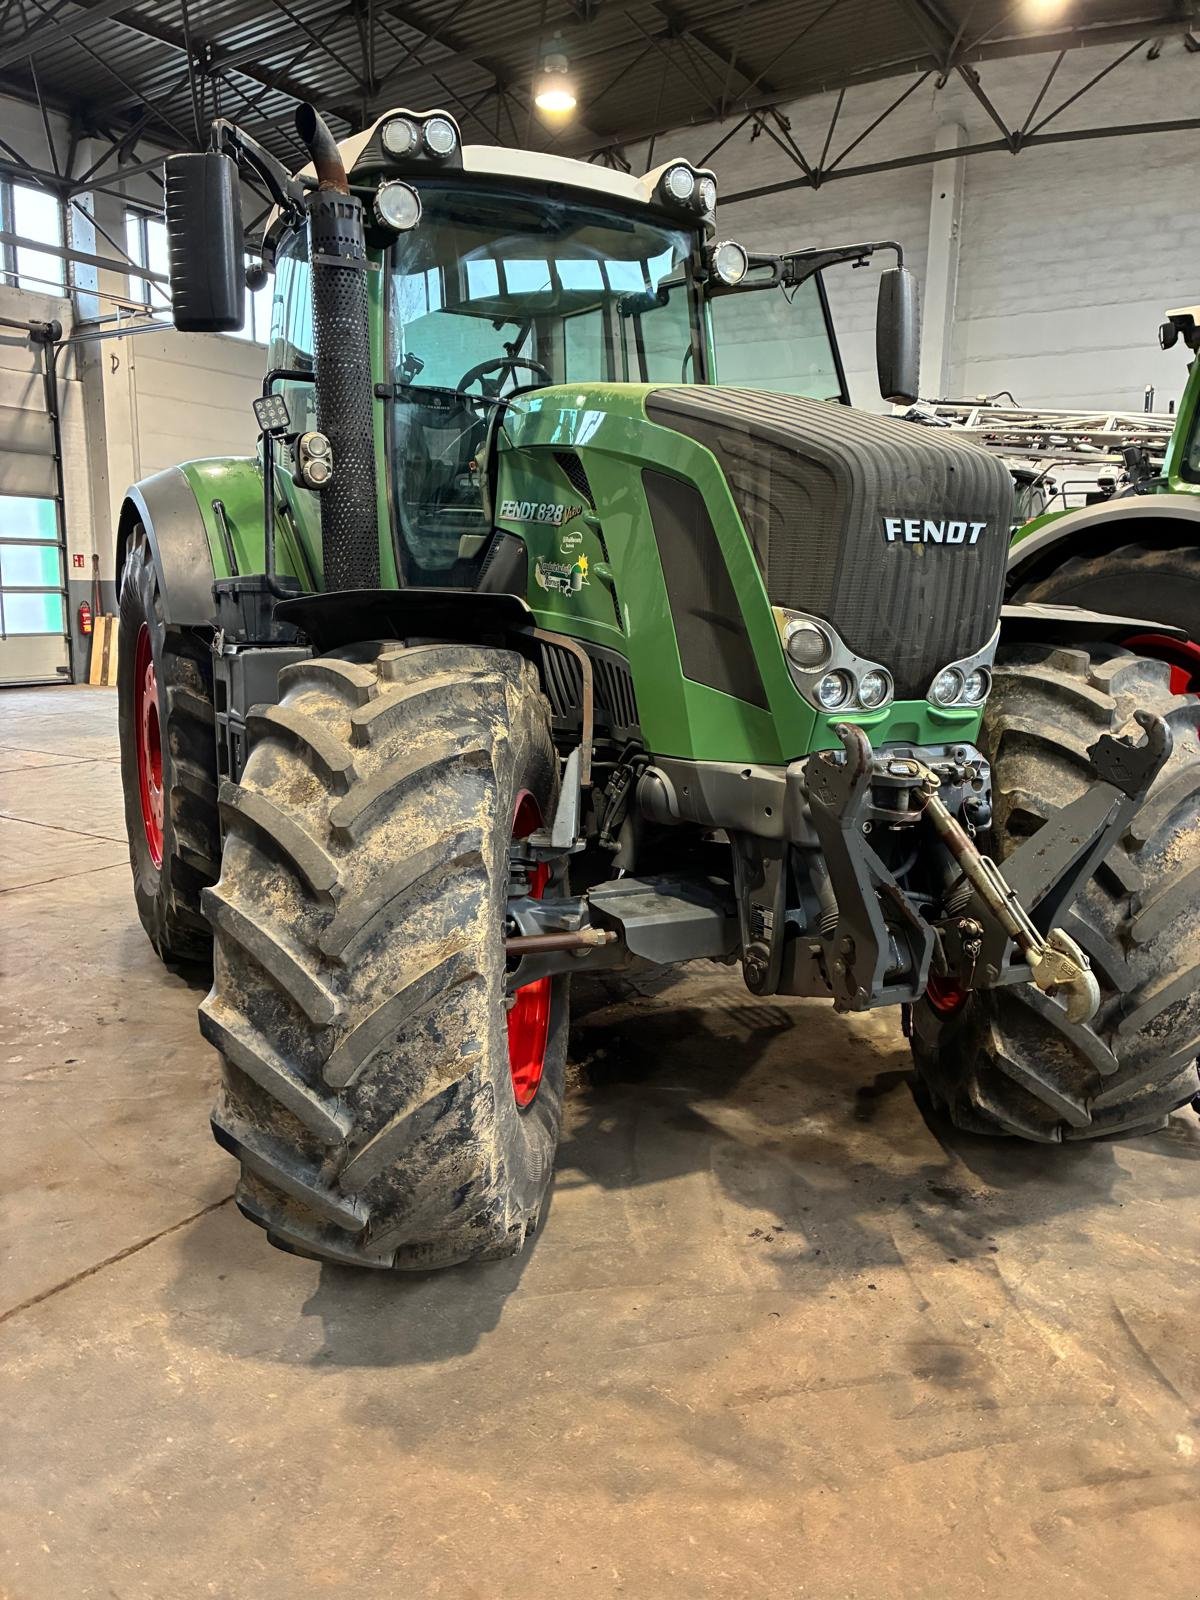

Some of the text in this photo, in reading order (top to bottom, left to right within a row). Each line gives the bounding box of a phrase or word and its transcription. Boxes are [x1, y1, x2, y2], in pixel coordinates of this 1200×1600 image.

[500, 500, 538, 520] FENDT
[537, 503, 564, 522] 828
[883, 517, 987, 545] FENDT
